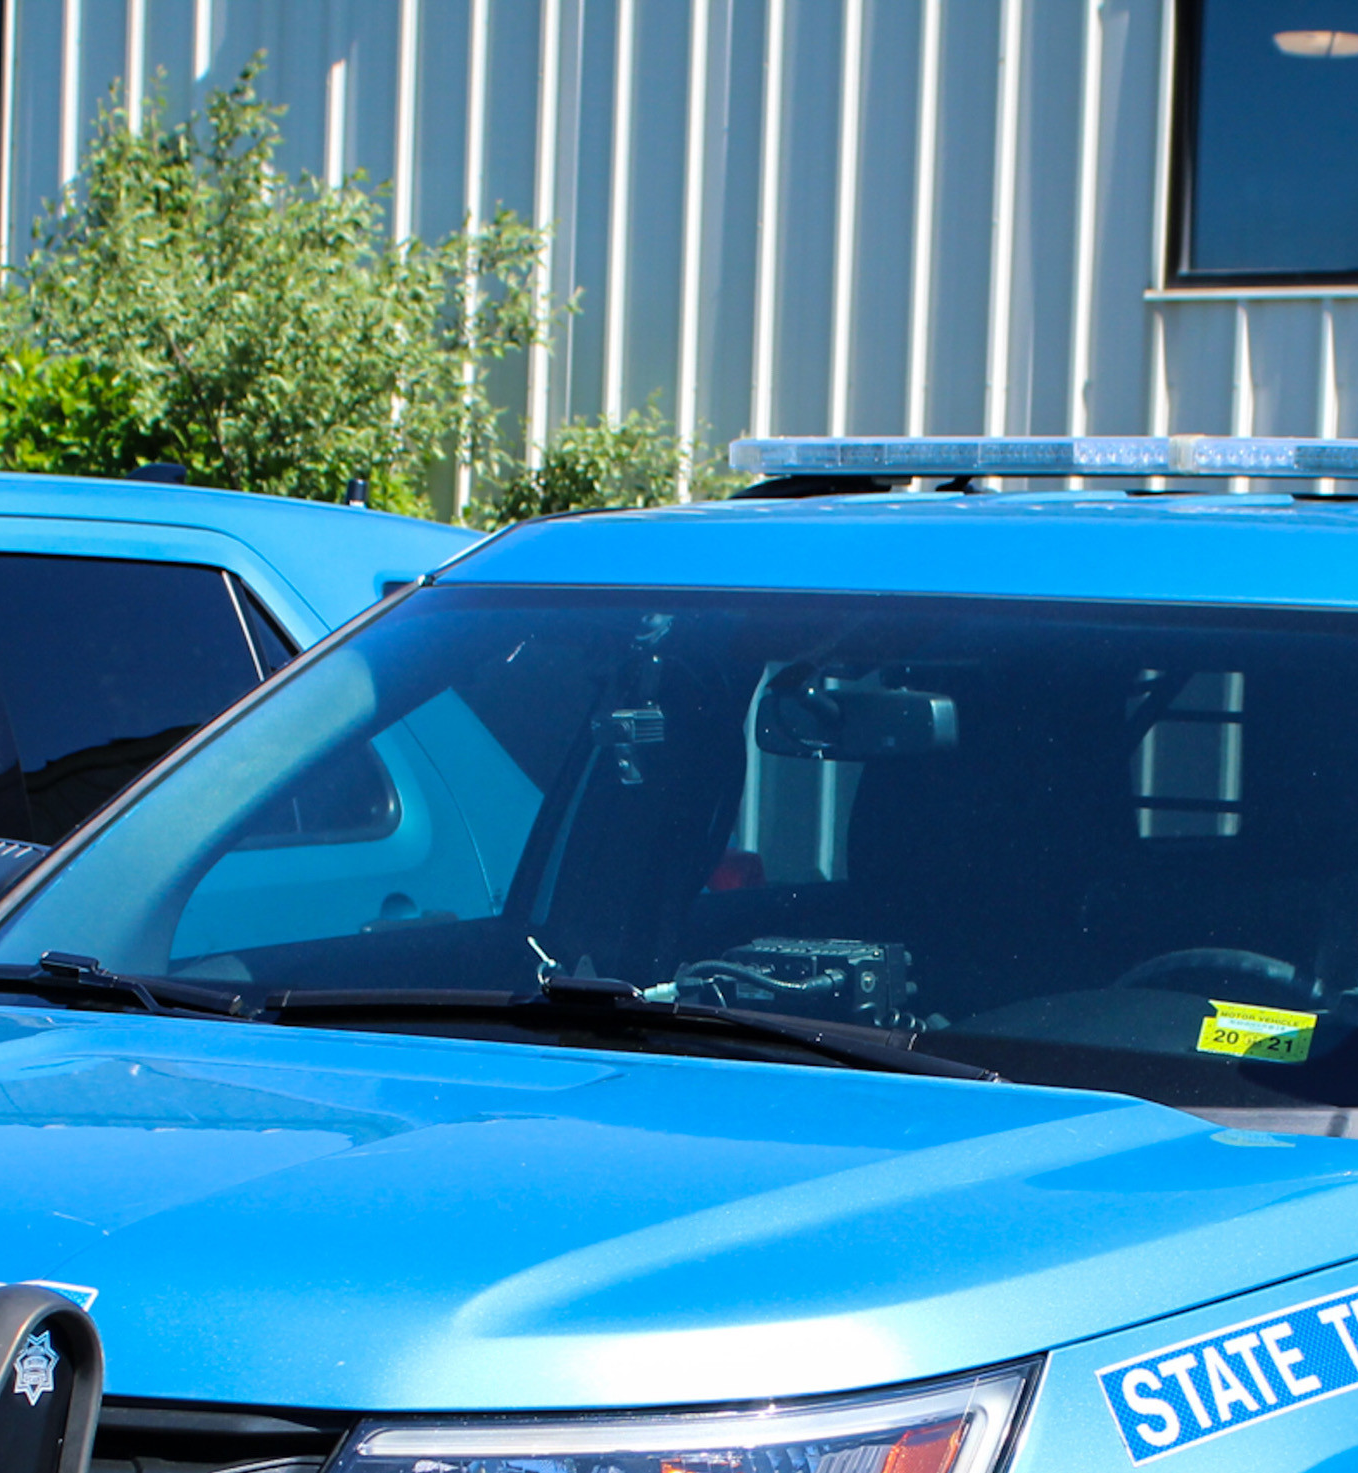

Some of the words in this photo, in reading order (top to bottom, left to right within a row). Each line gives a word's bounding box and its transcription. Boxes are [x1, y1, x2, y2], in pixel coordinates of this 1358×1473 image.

[1212, 1028, 1240, 1045] 20
[1266, 1036, 1293, 1054] 21
[1121, 1321, 1321, 1447] STATE
